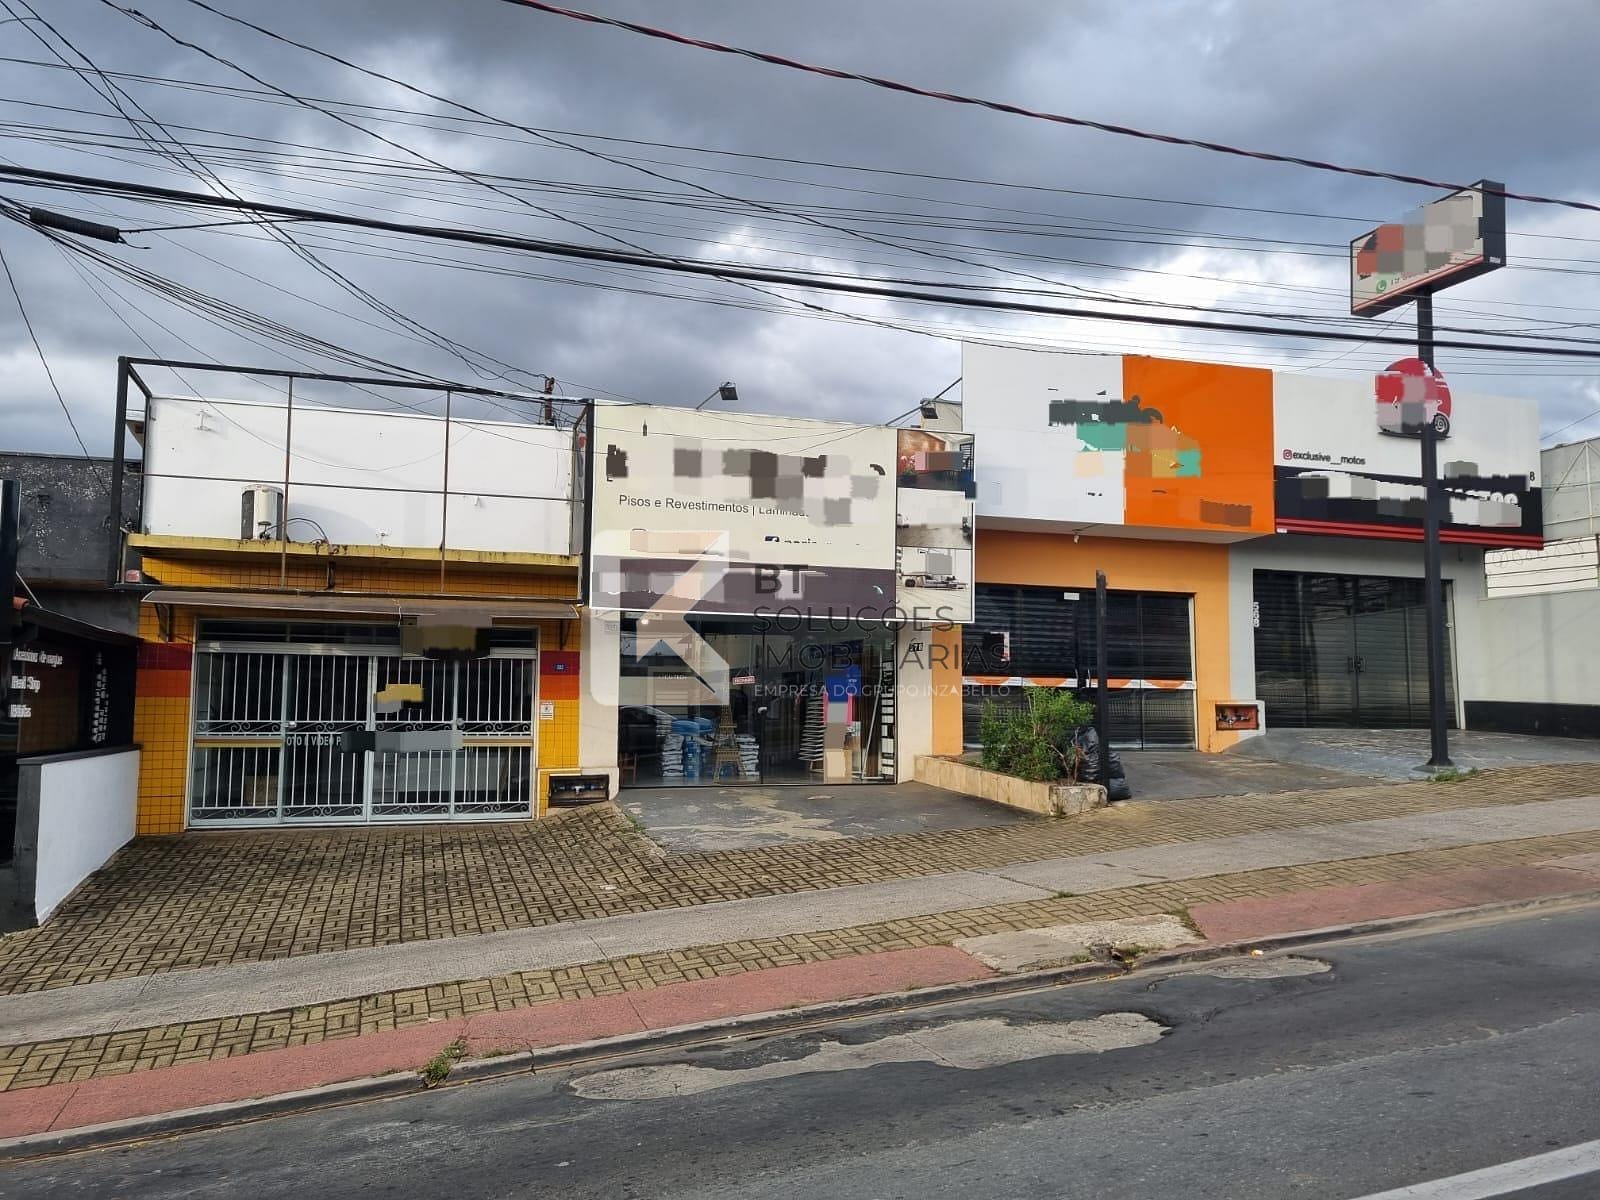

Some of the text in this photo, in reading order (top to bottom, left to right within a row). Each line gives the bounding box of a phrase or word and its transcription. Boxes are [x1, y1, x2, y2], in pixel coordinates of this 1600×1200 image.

[619, 494, 651, 507] Pisos
[654, 499, 662, 508] e
[665, 497, 749, 514] Revestimentos
